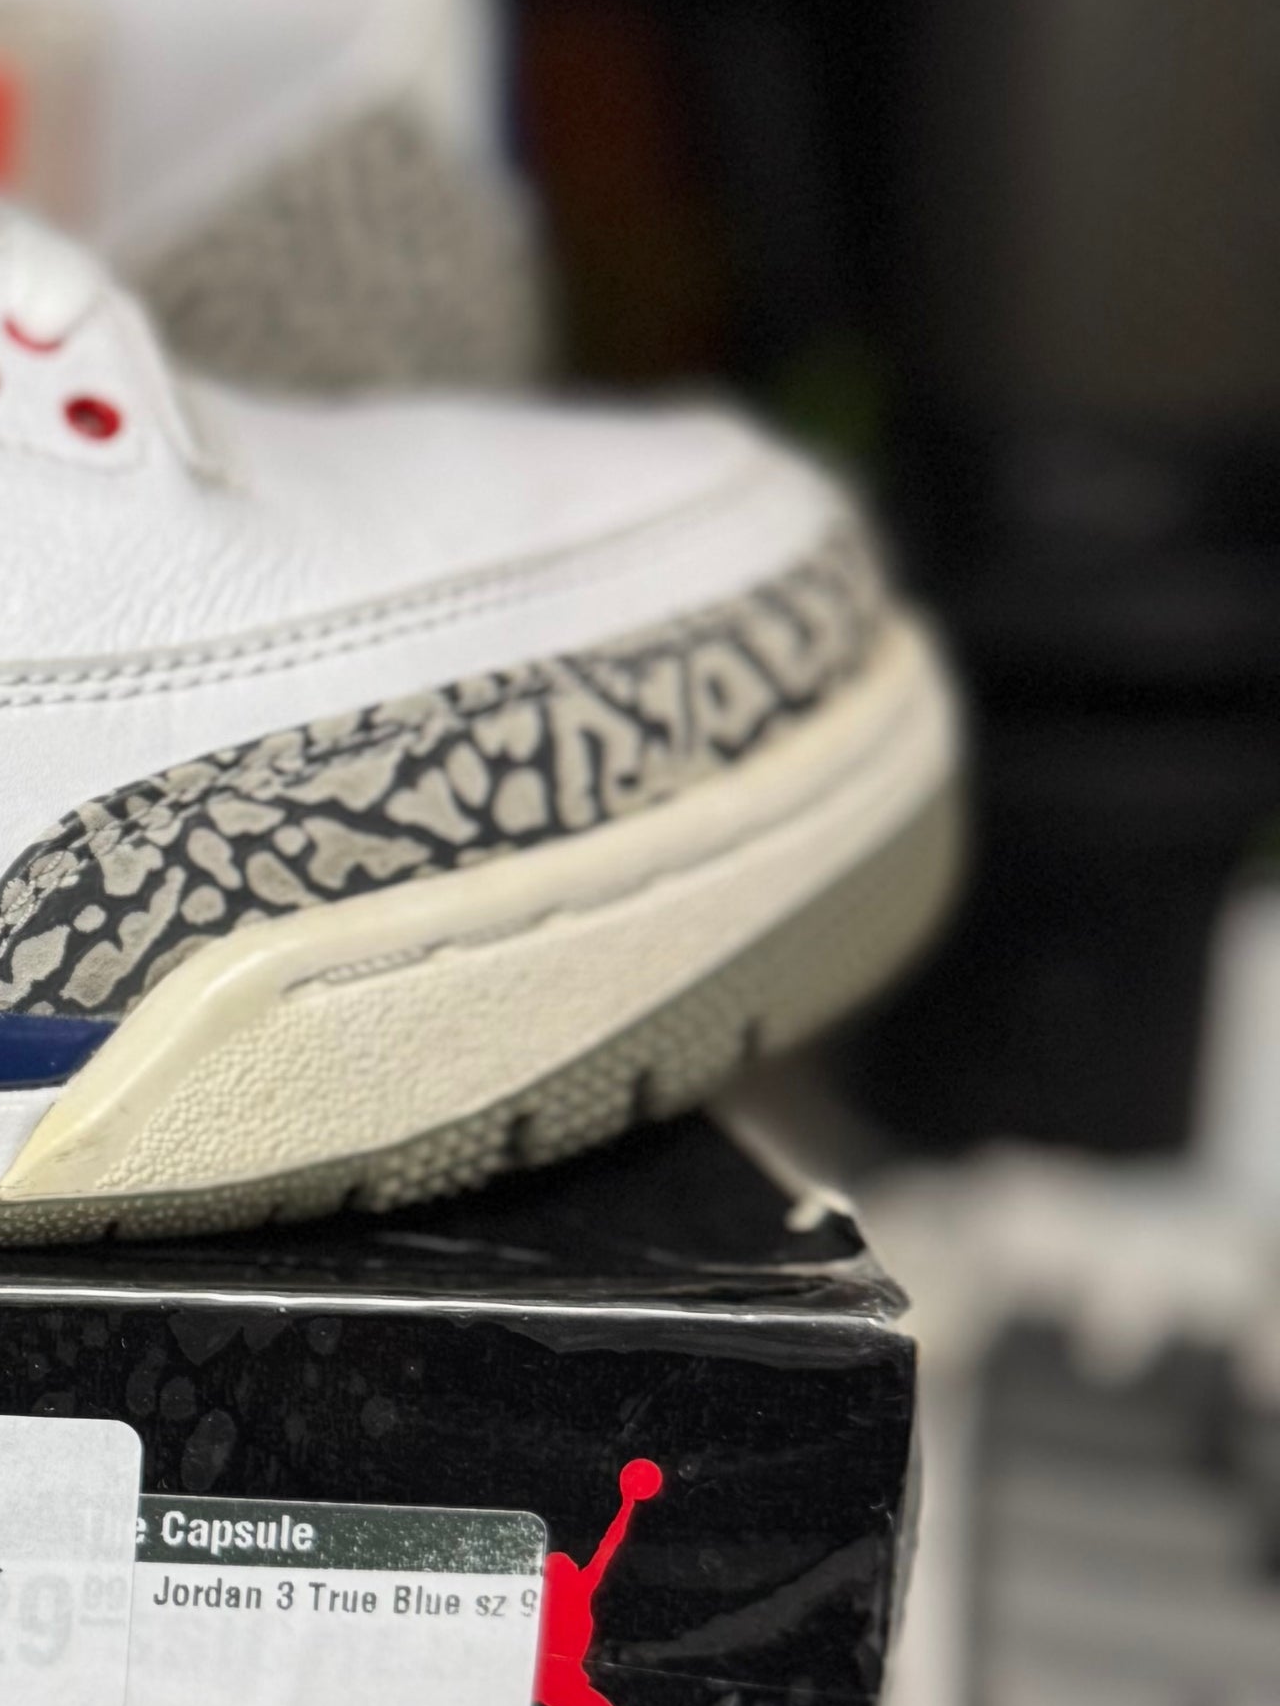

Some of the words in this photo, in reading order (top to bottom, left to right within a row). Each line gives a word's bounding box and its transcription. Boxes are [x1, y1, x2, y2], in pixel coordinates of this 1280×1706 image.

[161, 1509, 316, 1555] Capsule
[152, 1574, 263, 1610] Jordan
[275, 1580, 296, 1611] 3
[307, 1580, 378, 1614] True
[392, 1584, 461, 1616] Blue
[474, 1593, 508, 1618] sz
